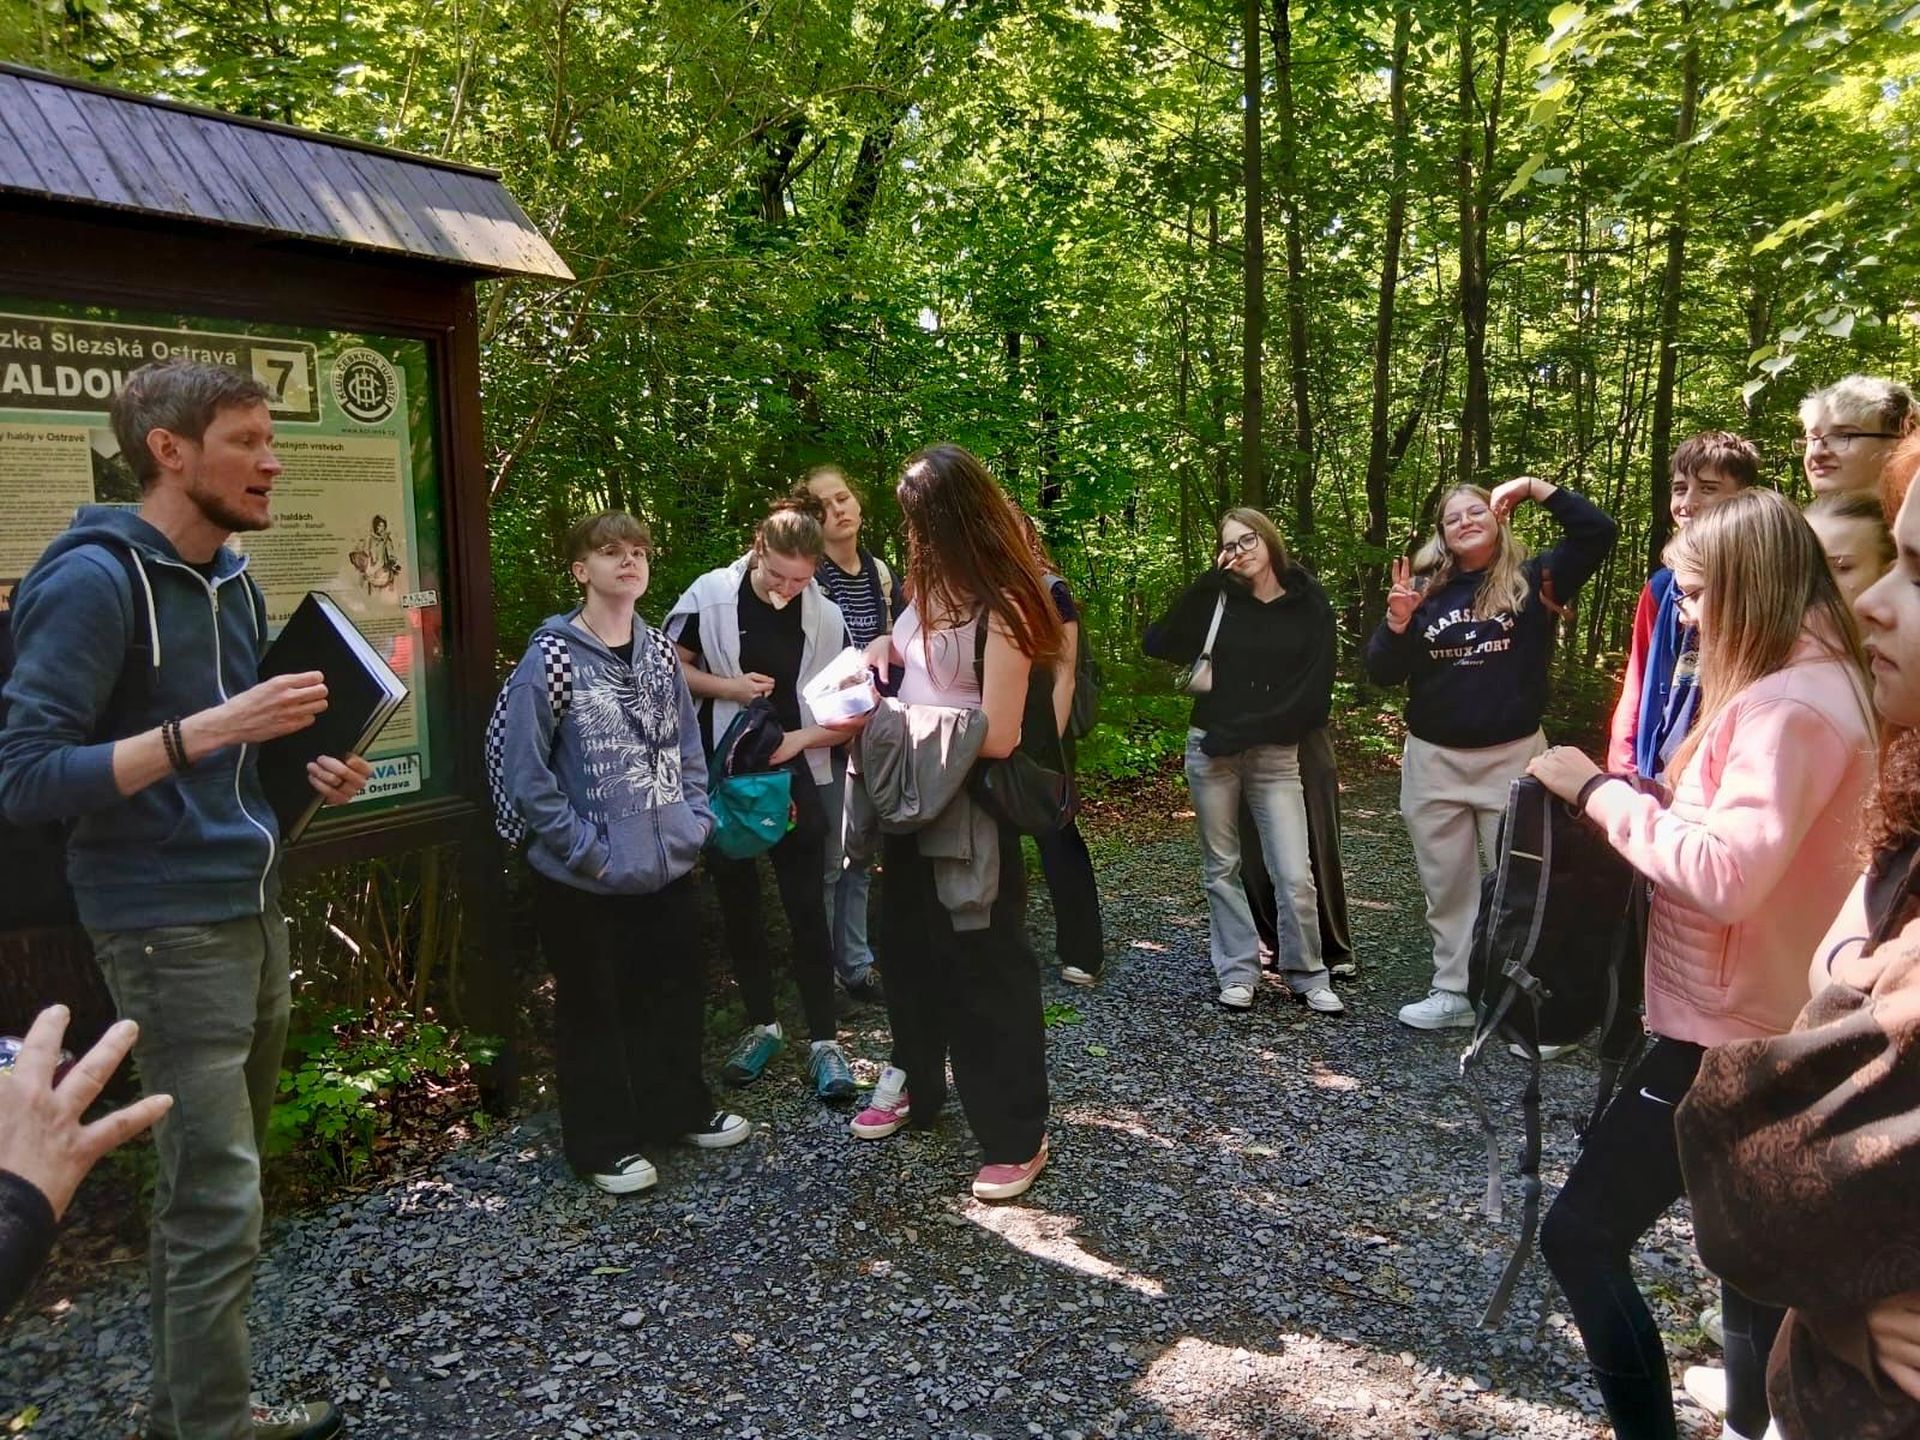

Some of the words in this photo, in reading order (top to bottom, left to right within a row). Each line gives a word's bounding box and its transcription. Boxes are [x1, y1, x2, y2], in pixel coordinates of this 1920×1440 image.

[51, 332, 144, 358] Slezská
[152, 341, 237, 366] Ostrava
[267, 359, 293, 400] 7
[1465, 630, 1477, 640] LE
[369, 780, 410, 793] Ostrava
